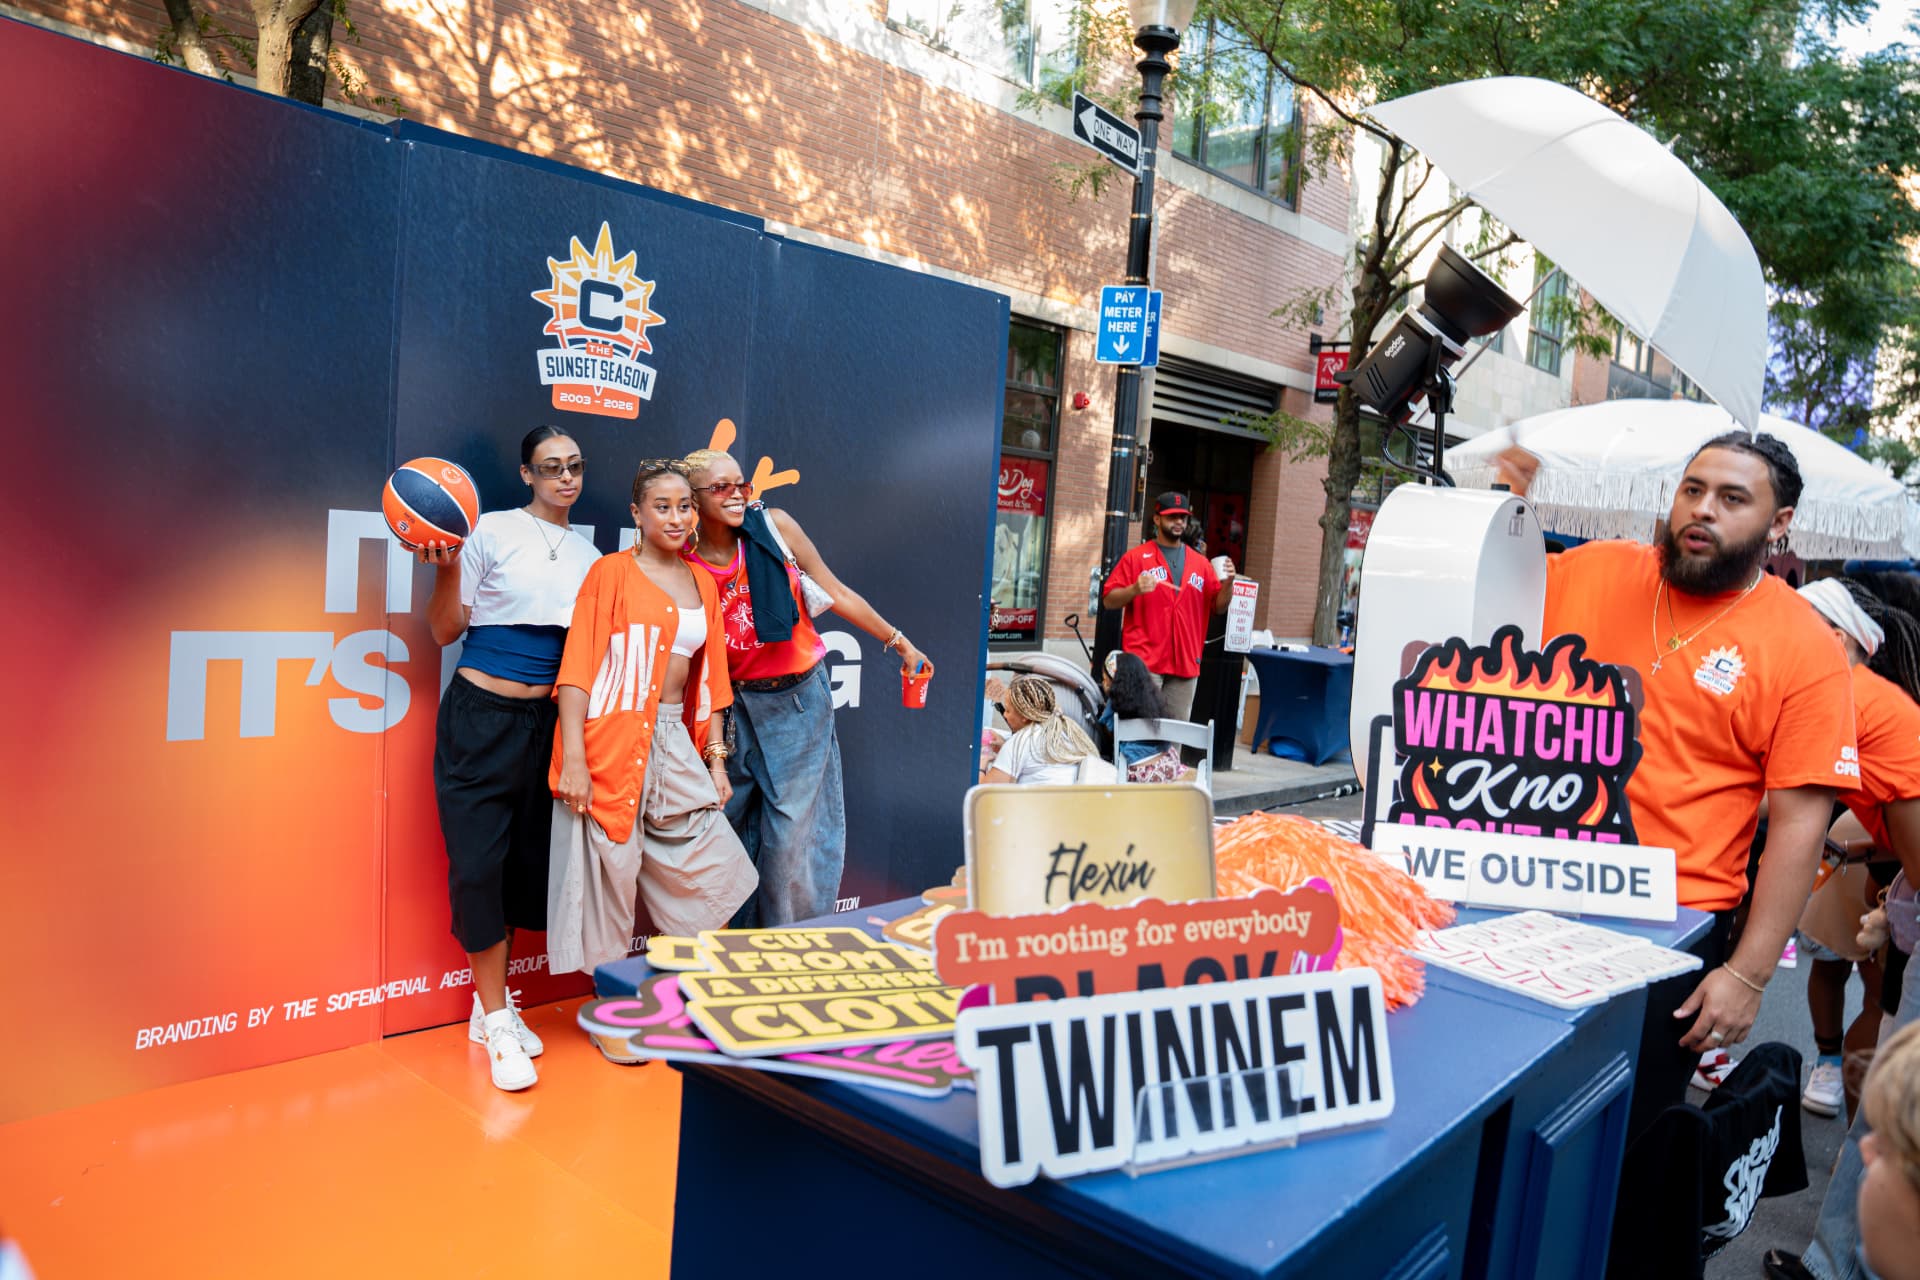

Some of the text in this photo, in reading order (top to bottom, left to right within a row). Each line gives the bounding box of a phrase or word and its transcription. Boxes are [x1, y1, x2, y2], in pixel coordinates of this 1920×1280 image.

[1093, 118, 1135, 155] ONE WAY
[579, 278, 624, 333] C
[1105, 306, 1142, 318] METER
[1114, 291, 1135, 303] PAY
[1107, 321, 1137, 333] HERE
[589, 344, 611, 356] THE
[546, 356, 650, 393] SUNSET SEASON
[559, 393, 591, 405] 2003
[1002, 468, 1036, 500] Dog
[720, 584, 751, 613] WNB
[1404, 689, 1625, 767] WHATCHU
[1446, 758, 1584, 818] Kno
[1044, 841, 1156, 898] Flexin
[1402, 845, 1652, 898] WE OUTSIDE
[747, 932, 836, 952] CUT
[956, 904, 1313, 964] I'm rooting for everybody
[727, 949, 896, 973] FROM
[708, 970, 941, 997] A DIFFEREN
[136, 1013, 239, 1051] BRANDING
[247, 1005, 274, 1029] BY
[283, 997, 319, 1022] THE
[439, 967, 476, 990] AGEN
[977, 984, 1383, 1165] TWINNEM
